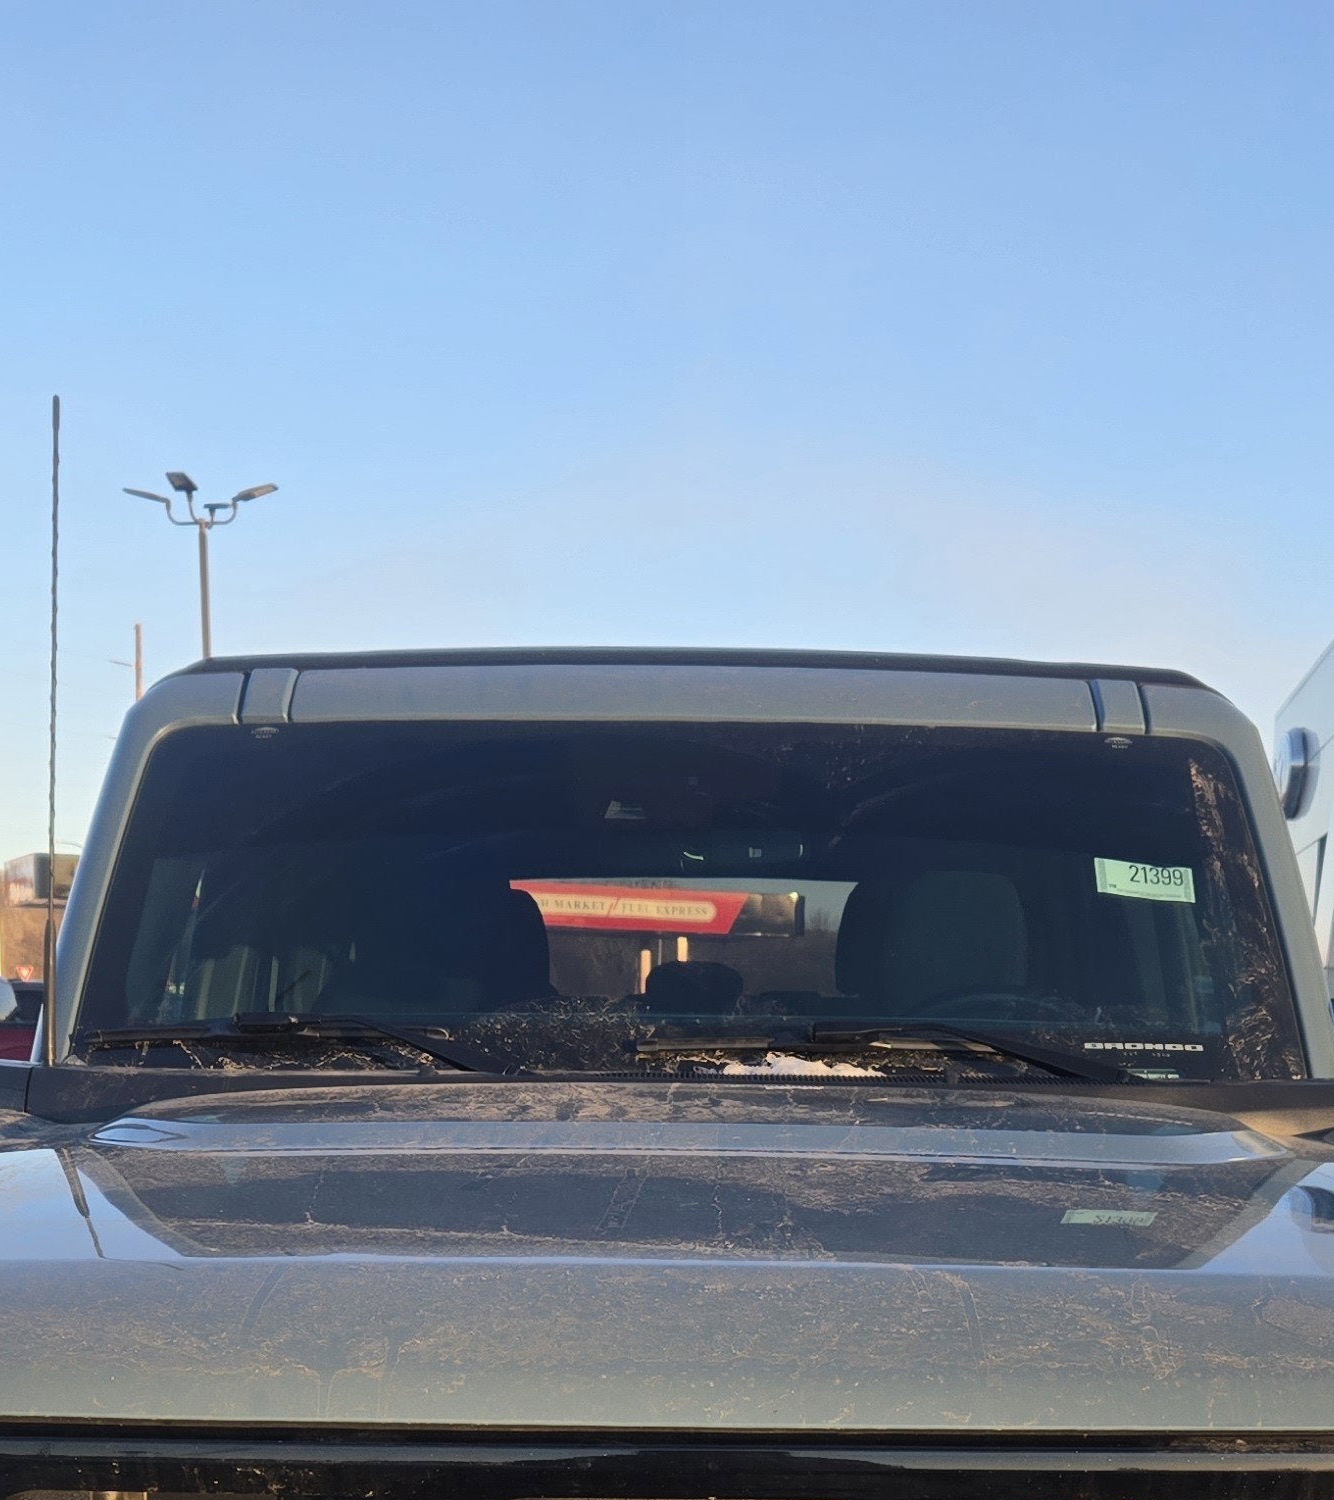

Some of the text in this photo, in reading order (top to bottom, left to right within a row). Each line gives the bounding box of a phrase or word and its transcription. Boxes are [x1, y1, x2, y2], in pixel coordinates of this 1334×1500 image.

[1128, 864, 1184, 887] 21399
[554, 898, 605, 911] MARKET
[621, 902, 652, 914] FUEL
[656, 905, 708, 916] EXPRESS
[1083, 1042, 1205, 1052] BRONCO
